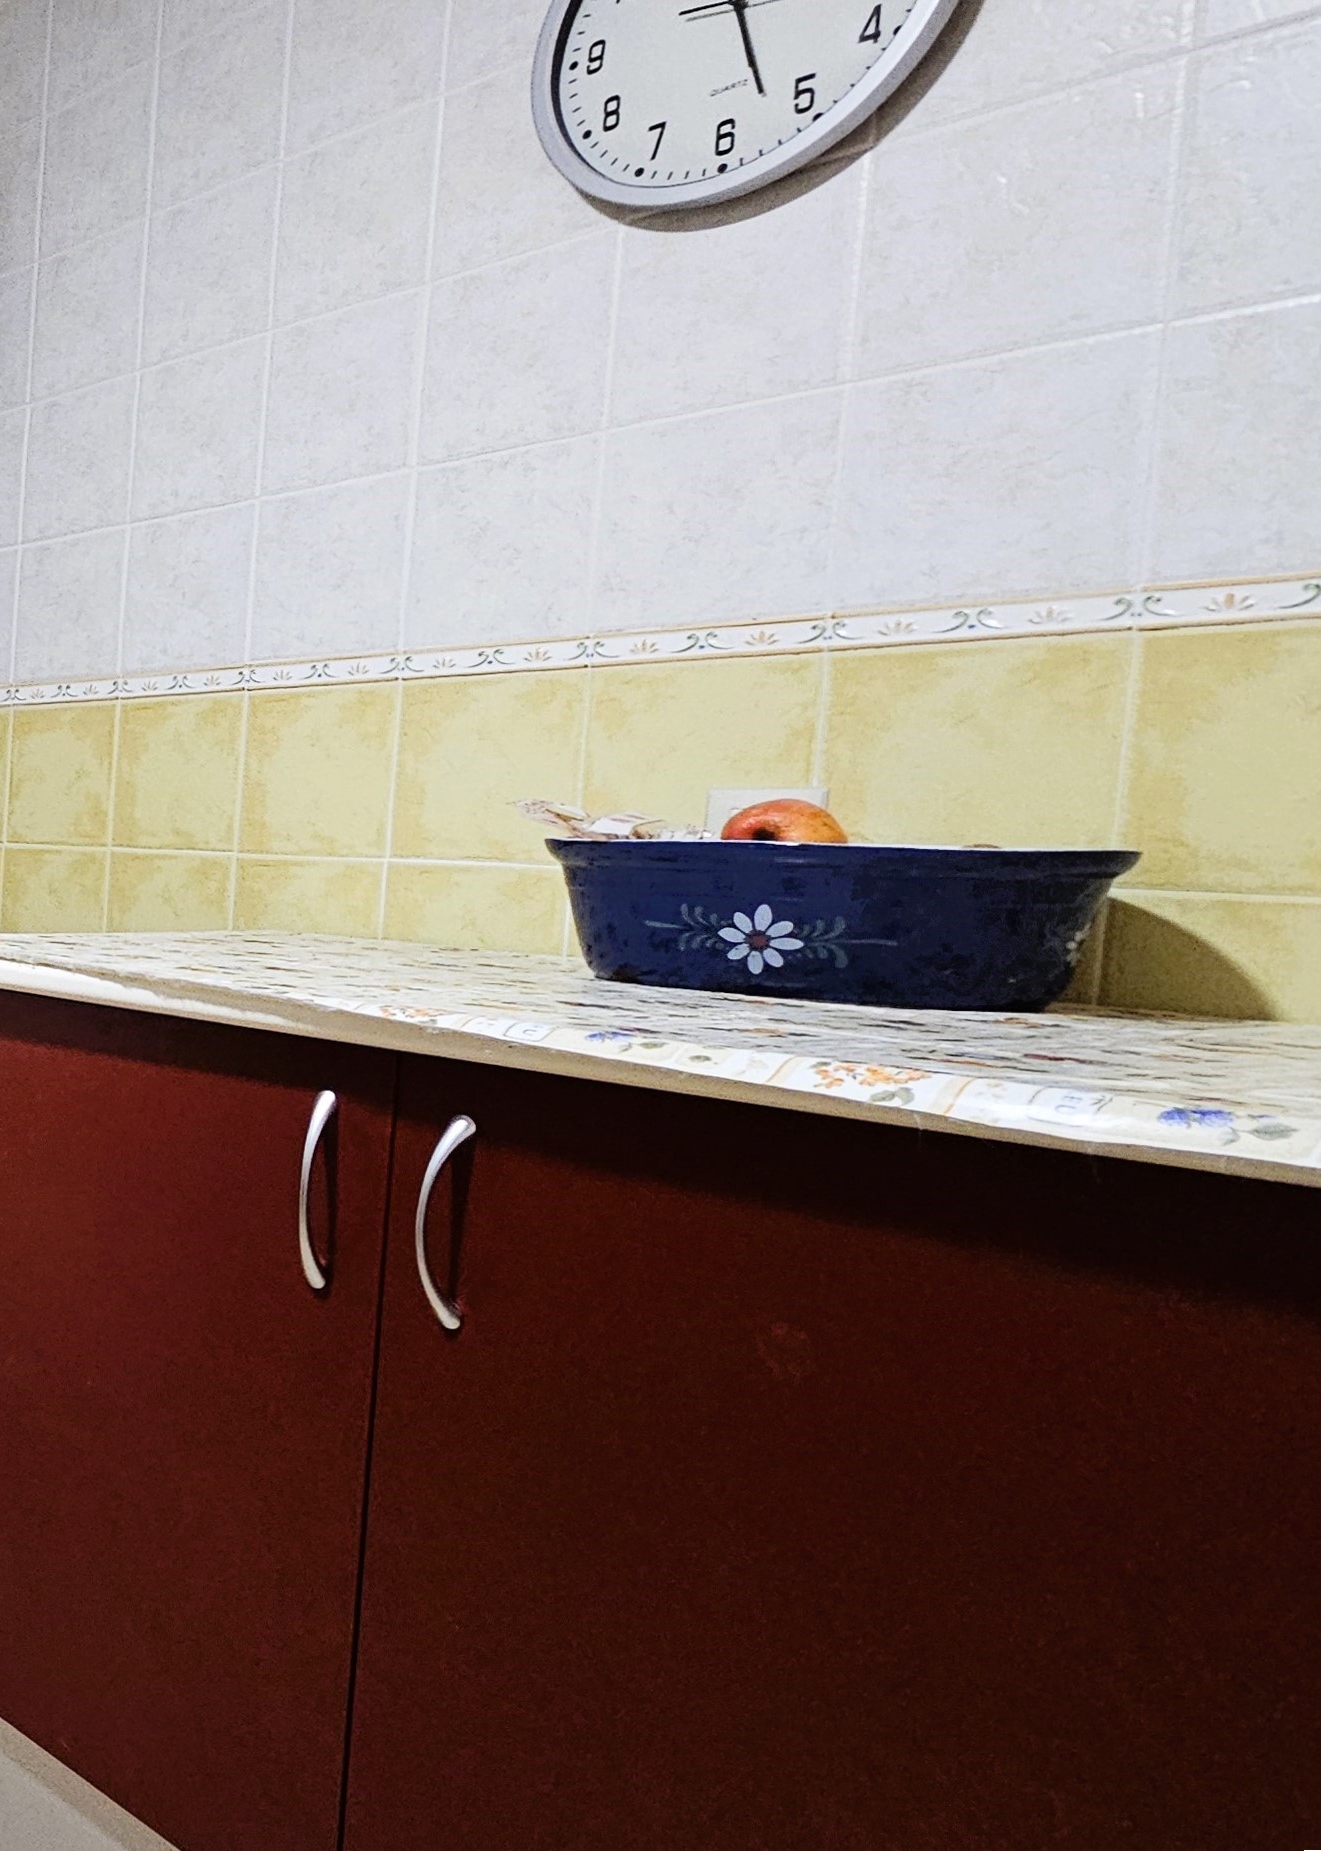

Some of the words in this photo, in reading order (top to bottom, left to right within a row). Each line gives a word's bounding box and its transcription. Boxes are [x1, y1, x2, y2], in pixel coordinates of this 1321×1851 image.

[858, 4, 882, 43] 4
[586, 39, 606, 75] 9
[709, 78, 748, 98] QUARTZ
[793, 72, 817, 115] 5
[603, 94, 621, 132] 8
[648, 121, 667, 161] 7
[714, 118, 736, 157] 6
